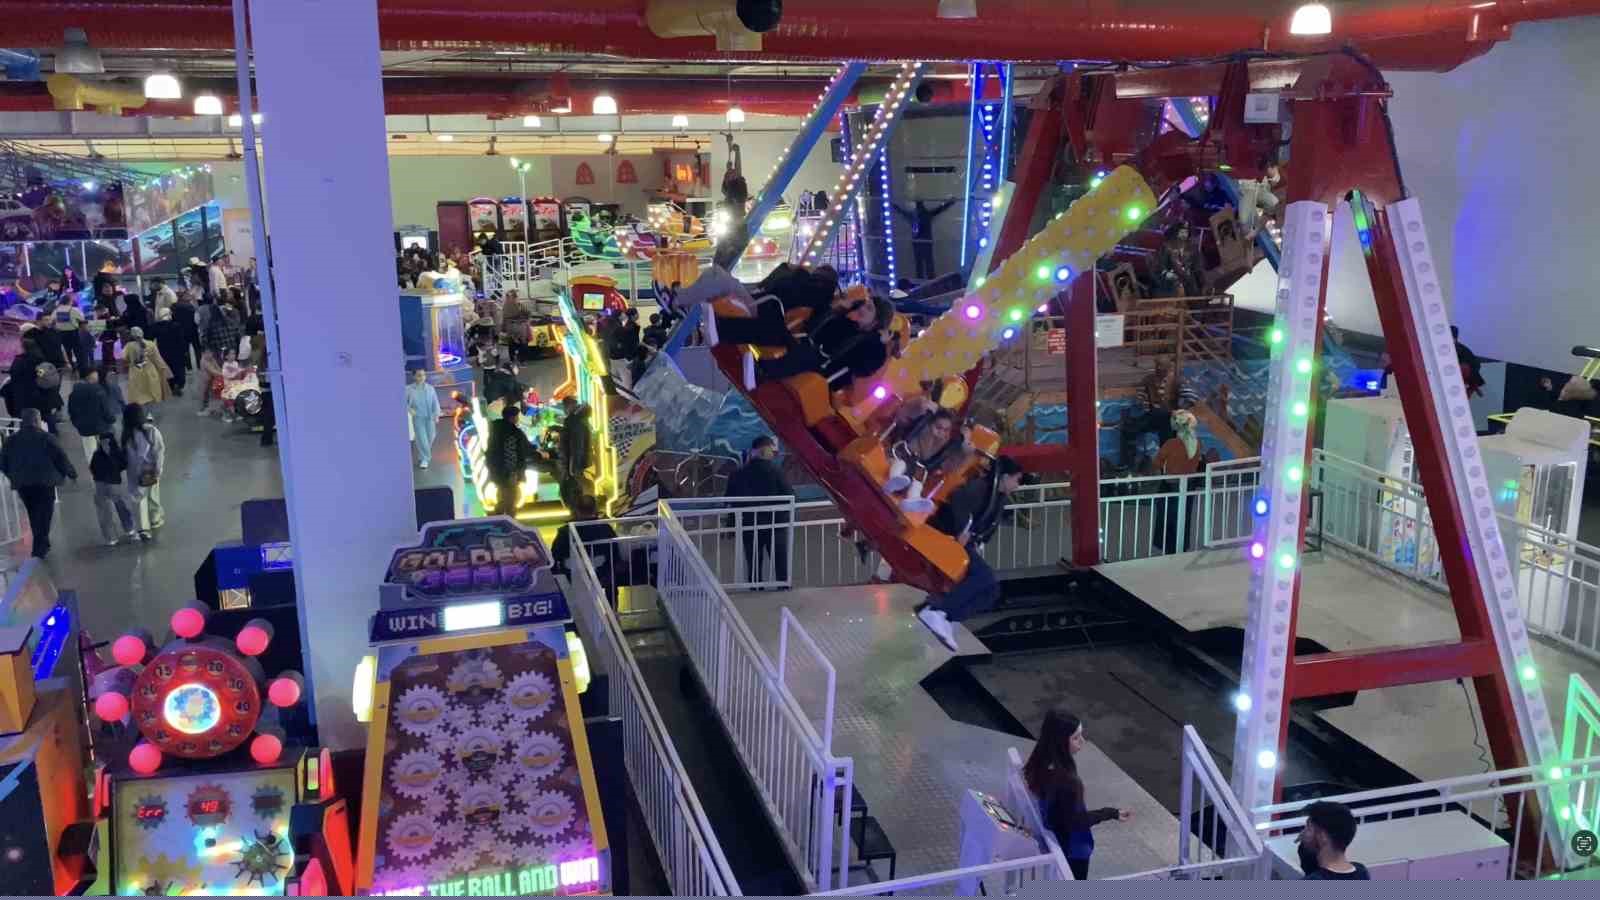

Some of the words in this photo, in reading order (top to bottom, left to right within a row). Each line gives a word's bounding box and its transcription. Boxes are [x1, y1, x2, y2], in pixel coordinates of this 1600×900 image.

[388, 612, 437, 632] WIN
[508, 600, 553, 619] BIG!
[467, 869, 516, 896] BALL
[517, 863, 558, 895] AND
